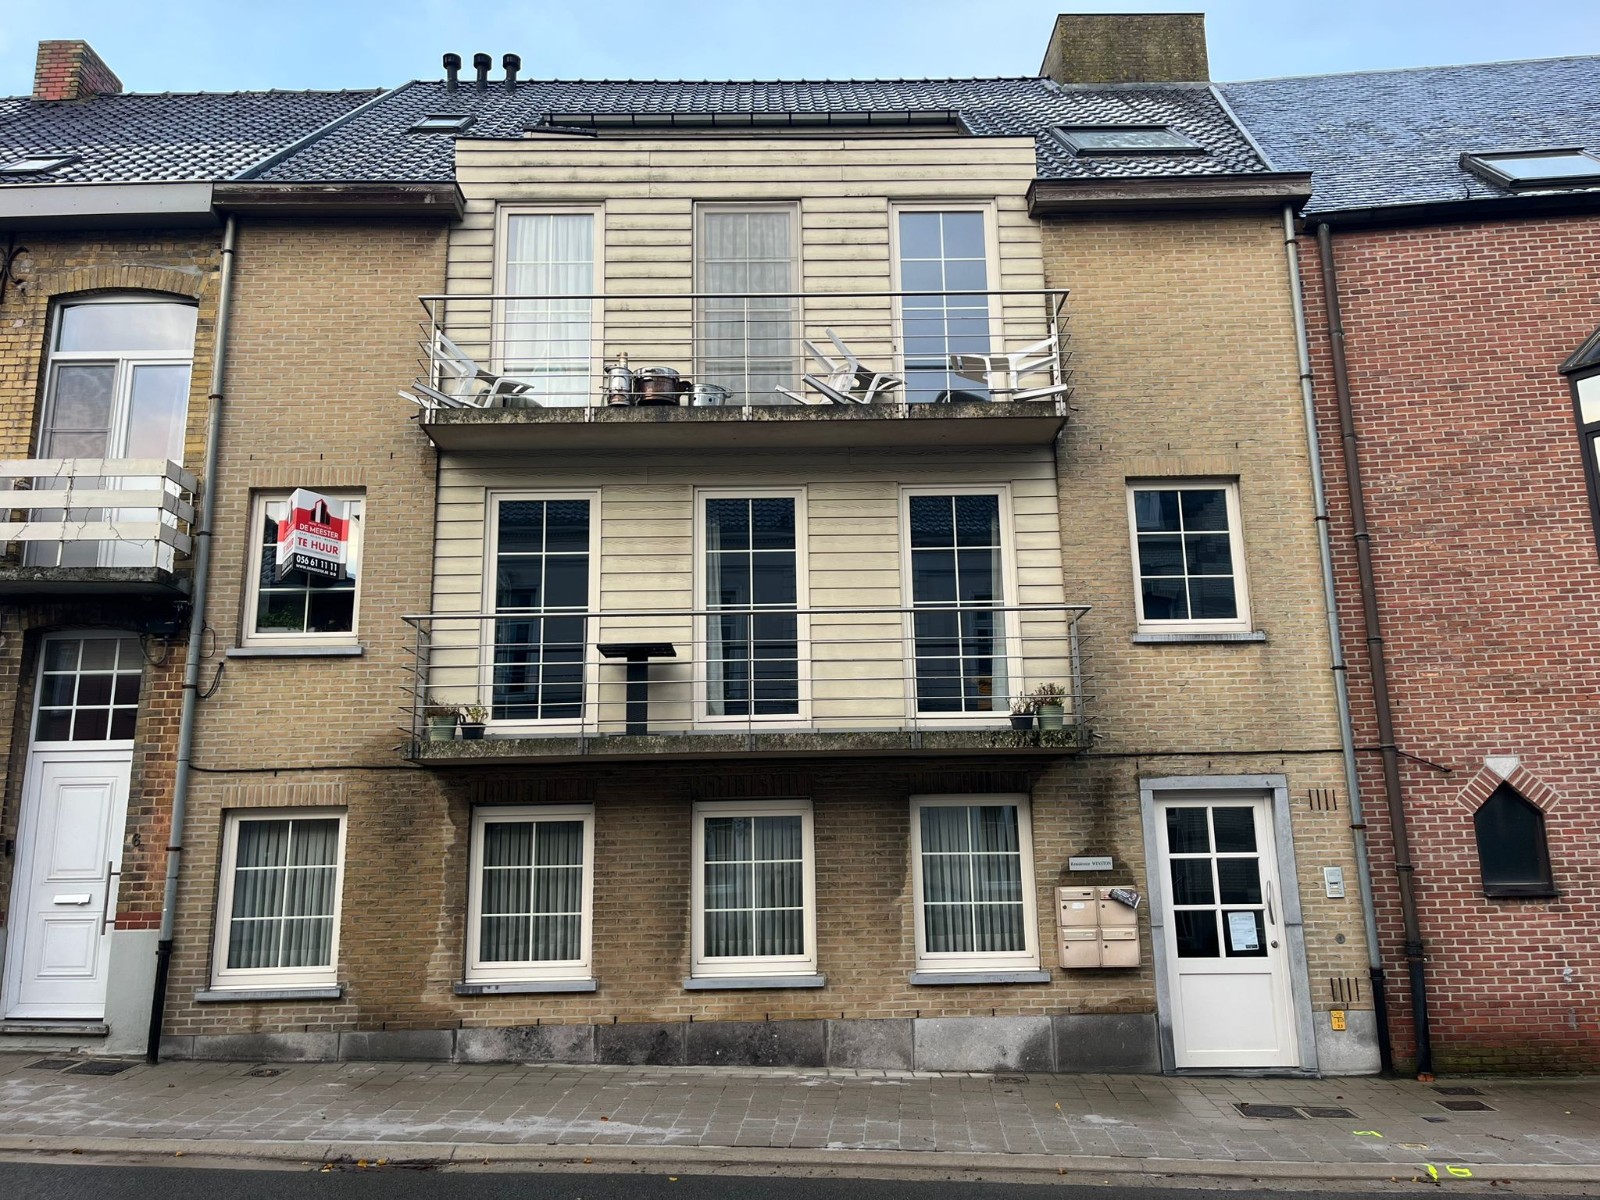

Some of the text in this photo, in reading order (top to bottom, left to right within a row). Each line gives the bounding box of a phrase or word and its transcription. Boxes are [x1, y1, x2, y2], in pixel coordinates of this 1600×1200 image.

[299, 523, 309, 531] DE
[310, 526, 339, 539] MEESTER
[298, 537, 308, 547] TE
[310, 540, 339, 555] HUUR
[296, 555, 337, 571] 056 61 11 11
